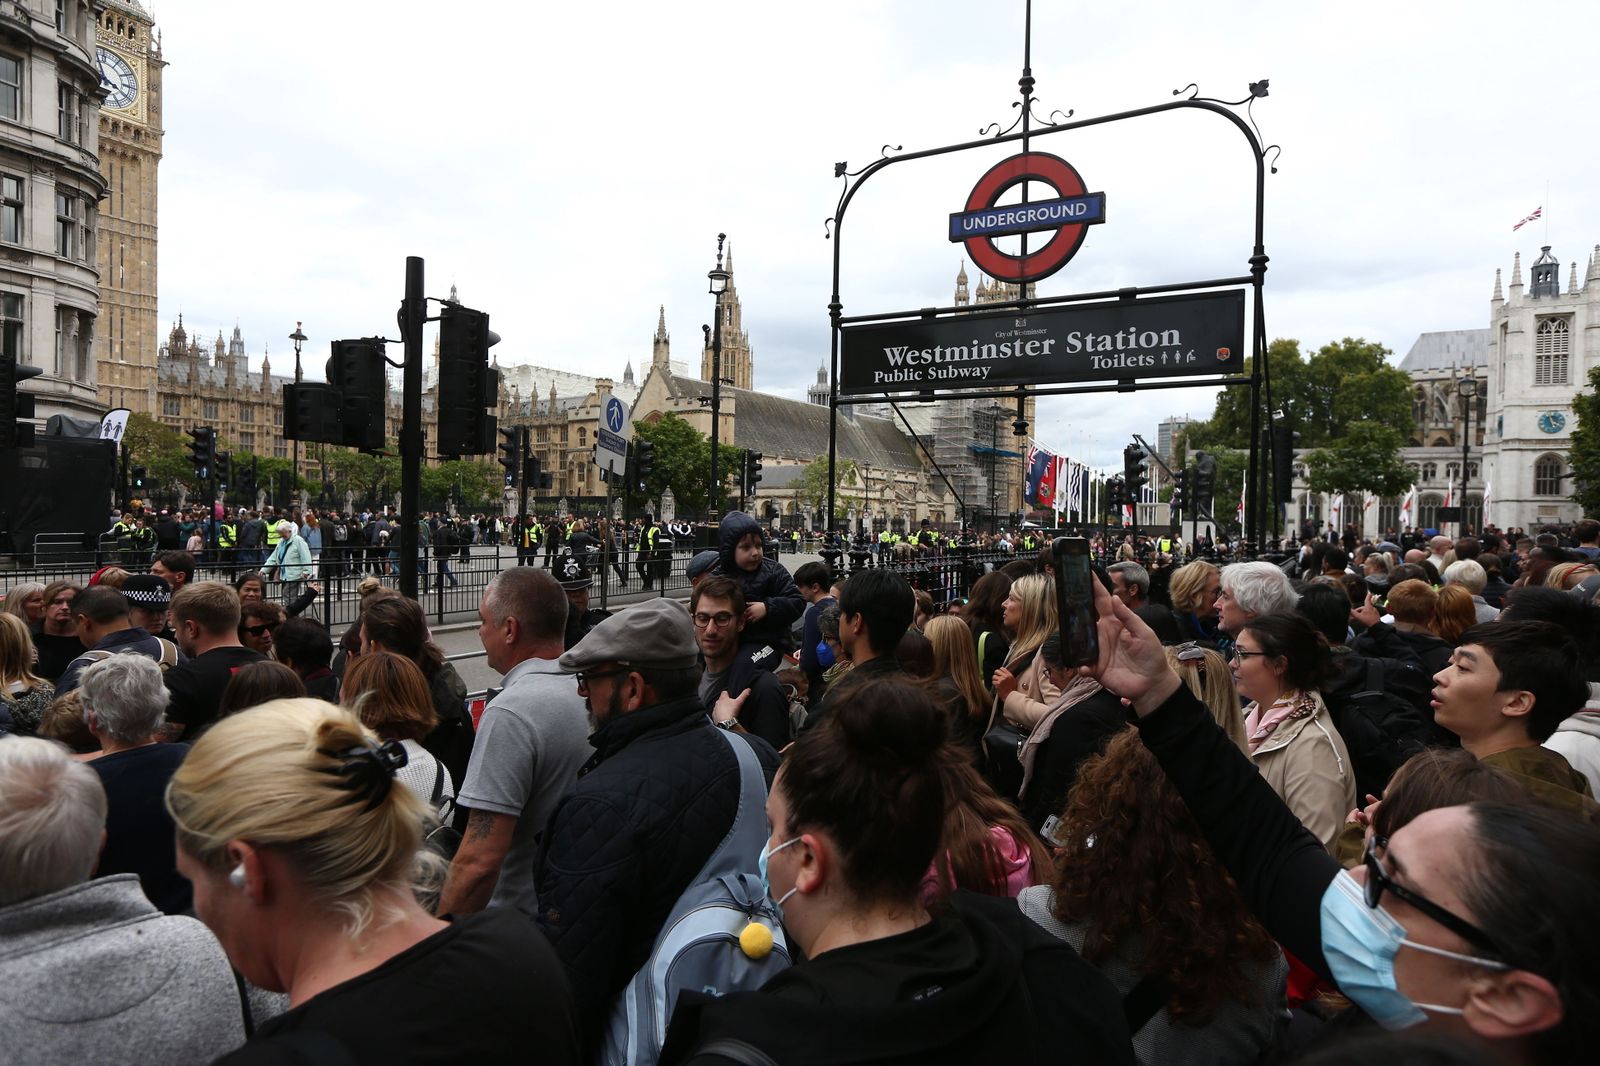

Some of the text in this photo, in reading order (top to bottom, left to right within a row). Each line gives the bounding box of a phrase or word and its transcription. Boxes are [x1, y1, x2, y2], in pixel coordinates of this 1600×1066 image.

[963, 203, 1087, 230] UNDERGROUND
[995, 328, 1047, 339] City of Westminster
[883, 327, 1181, 366] Westminster Station
[1090, 353, 1155, 369] Toilets
[874, 365, 991, 383] Public Subway
